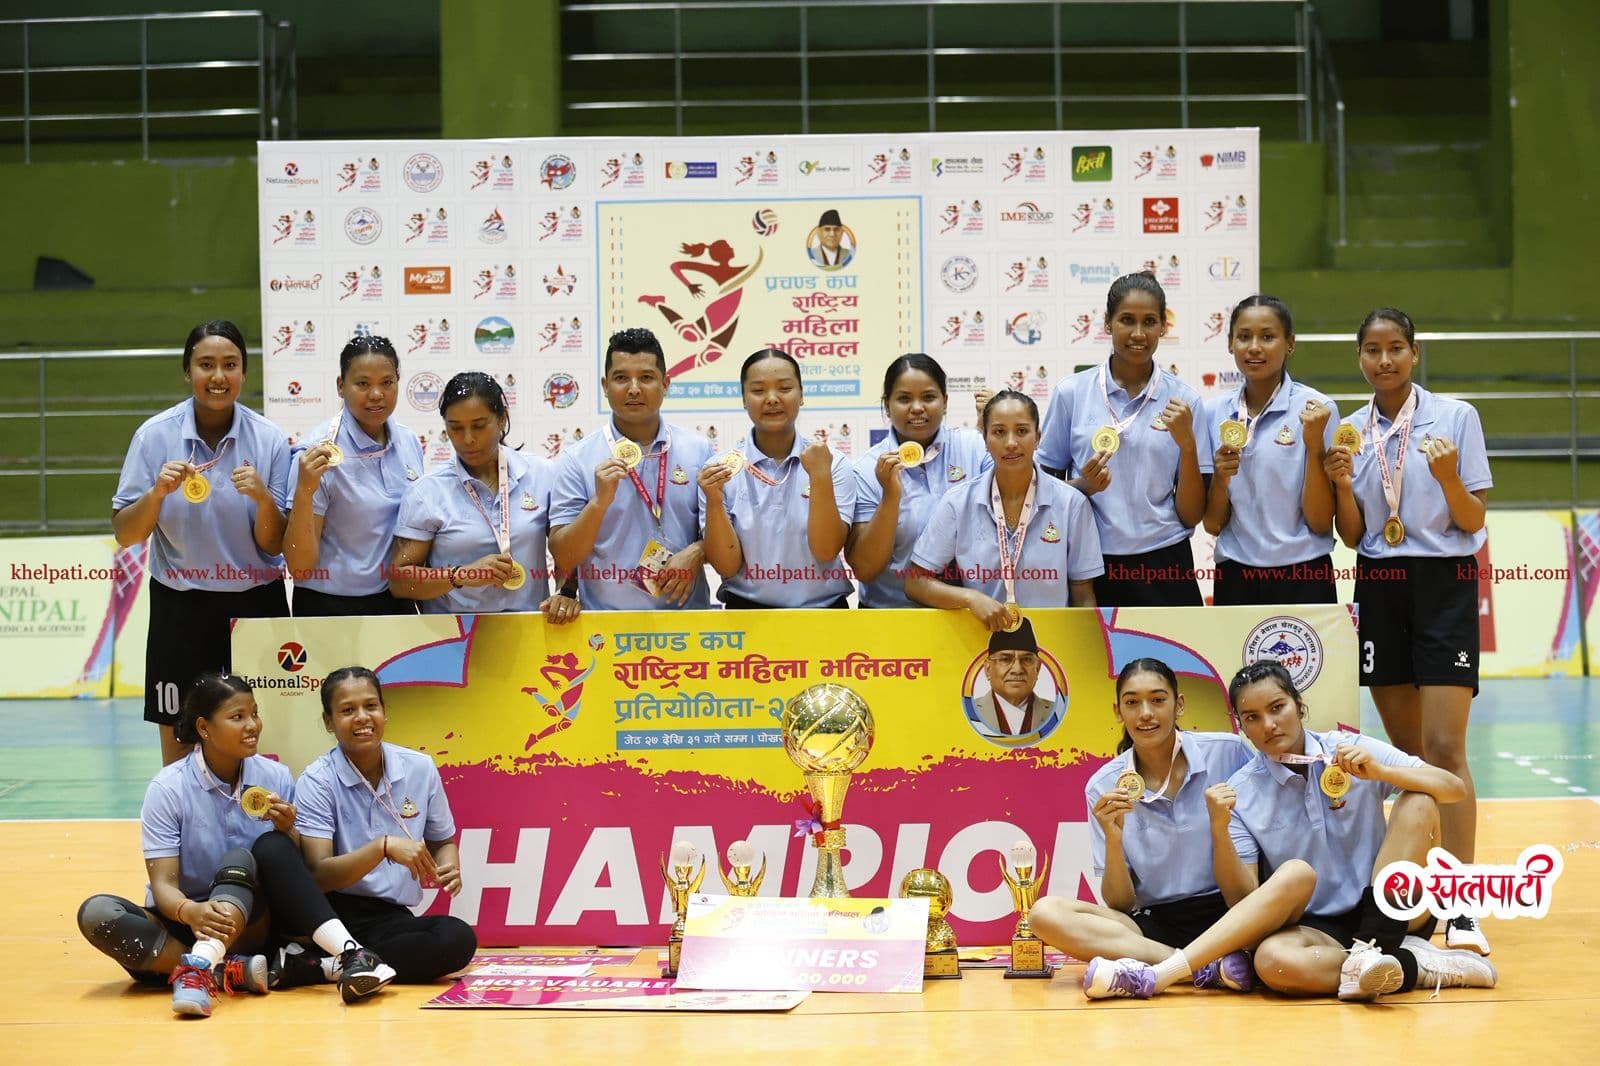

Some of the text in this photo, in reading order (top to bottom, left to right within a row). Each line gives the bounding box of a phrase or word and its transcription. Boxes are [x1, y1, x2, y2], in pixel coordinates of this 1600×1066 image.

[1216, 151, 1246, 163] NIMB
[1000, 212, 1026, 221] IME
[765, 275, 858, 292] प्रचण्ड कप
[792, 292, 859, 313] राष्ट्रिय
[782, 315, 859, 337] महिला
[614, 632, 746, 656] प्रचण्ड कप
[1363, 640, 1375, 674] 3
[613, 652, 932, 689] राष्ट्रिय महिला भलिबल
[156, 680, 180, 715] 10
[624, 734, 642, 745] जेठ
[645, 736, 659, 746] २७
[662, 733, 684, 746] देखि
[687, 735, 701, 745] ३१
[704, 733, 721, 744] गते
[724, 734, 748, 744] सम्म
[471, 978, 669, 989] MOST VALUABLE
